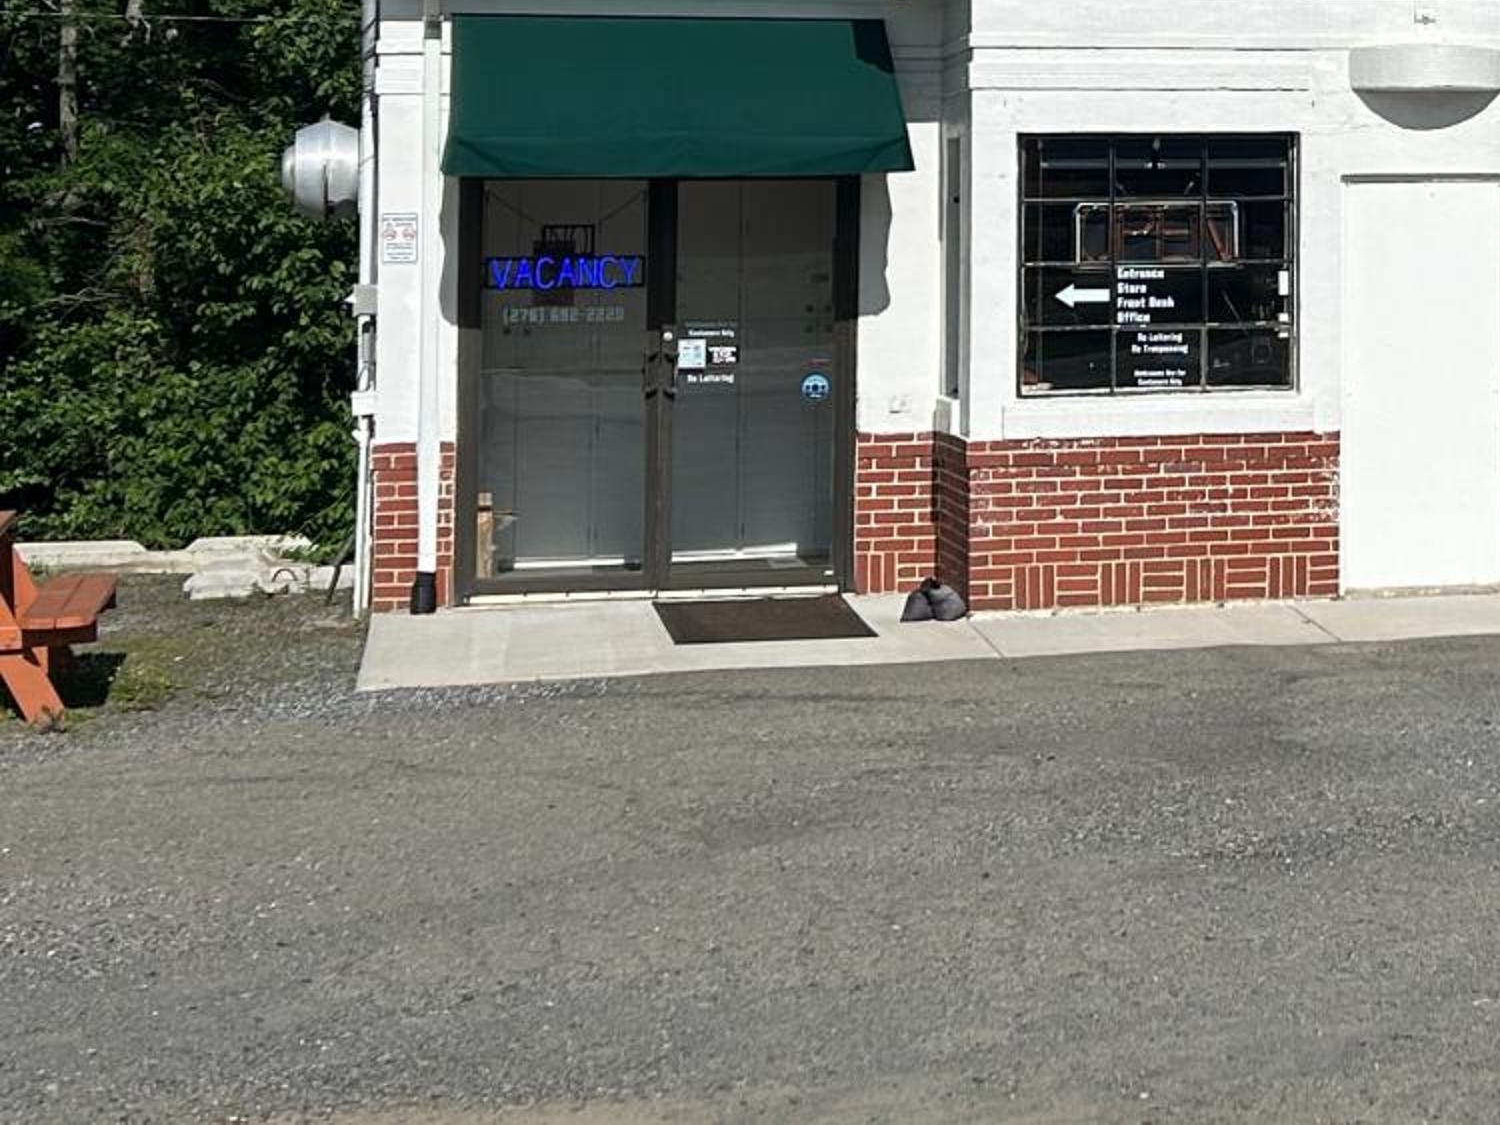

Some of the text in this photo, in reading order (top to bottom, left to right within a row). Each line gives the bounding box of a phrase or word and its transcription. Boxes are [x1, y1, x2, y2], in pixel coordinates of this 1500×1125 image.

[491, 255, 639, 291] VACANCY
[1117, 266, 1165, 280] Entrance
[1117, 282, 1147, 294] Store
[1117, 296, 1146, 309] Front
[1117, 311, 1151, 324] Office
